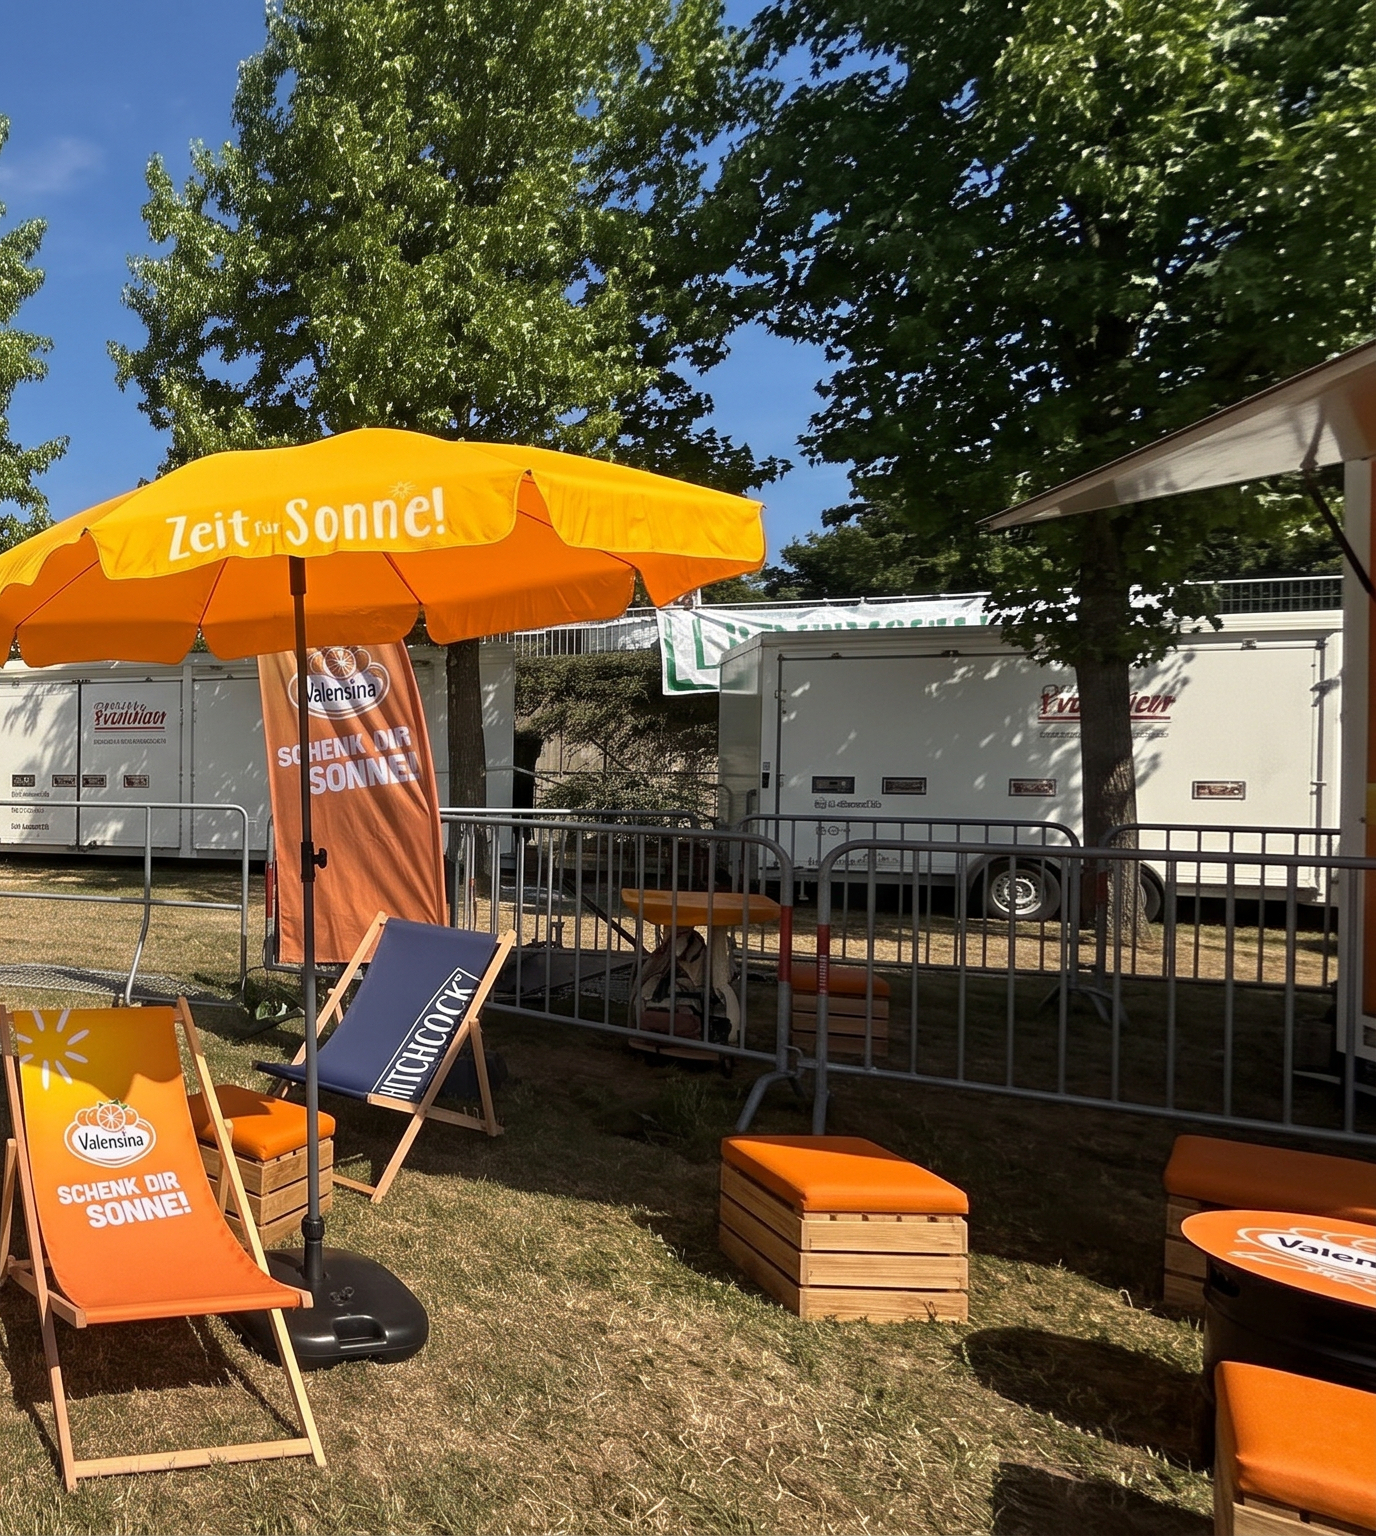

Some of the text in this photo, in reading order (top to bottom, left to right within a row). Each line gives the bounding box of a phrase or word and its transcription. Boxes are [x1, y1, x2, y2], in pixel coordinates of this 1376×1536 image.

[165, 510, 249, 562] Zeit
[285, 486, 445, 546] Sonne!
[277, 725, 412, 768] SCHENK DIR
[309, 751, 421, 796] SONNE!
[77, 1130, 145, 1151] Valensina
[57, 1170, 181, 1206] SCHENK DIR
[85, 1190, 193, 1229] SONNE!
[1277, 1236, 1376, 1269] Valen
